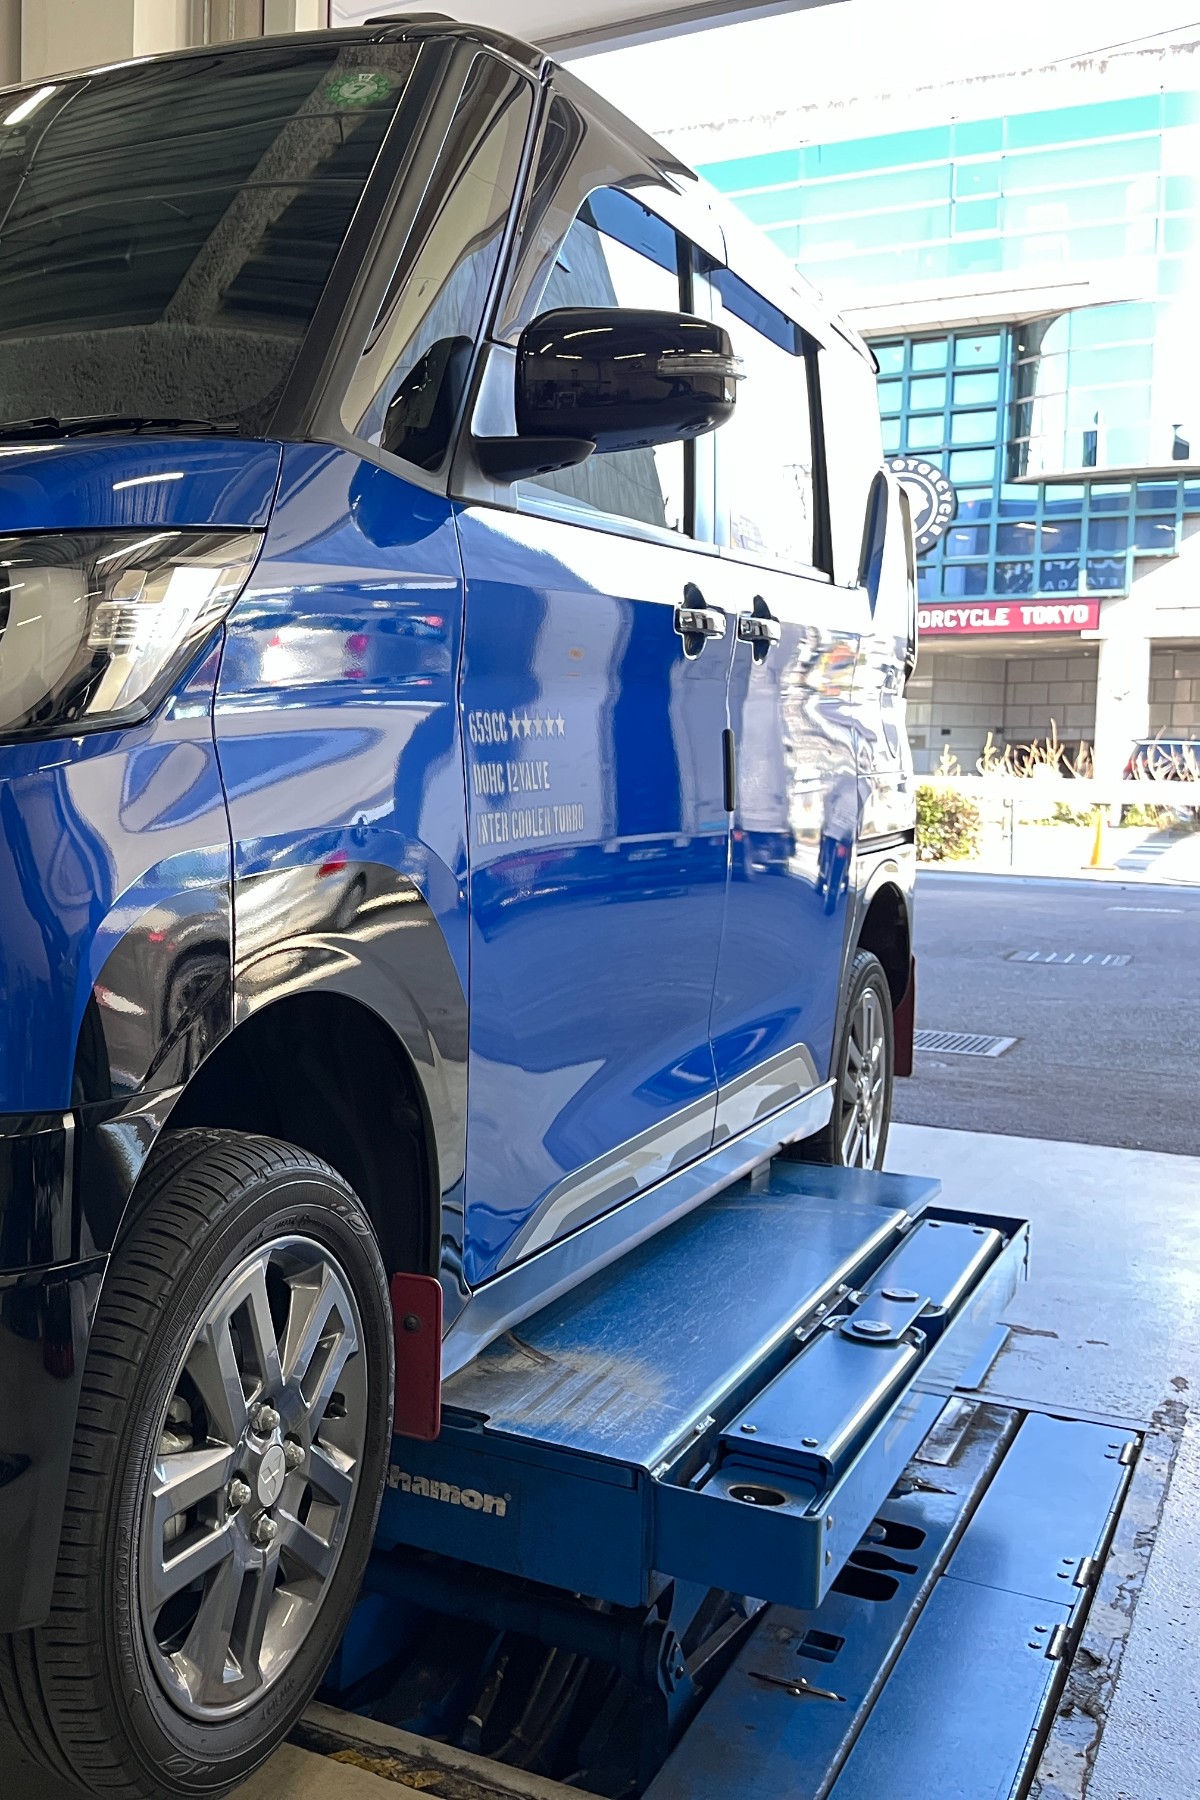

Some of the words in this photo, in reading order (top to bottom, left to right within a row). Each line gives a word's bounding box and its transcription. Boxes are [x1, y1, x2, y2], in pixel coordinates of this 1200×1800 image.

[917, 607, 1011, 629] ORCYCLE
[1020, 604, 1089, 625] TOKYO
[468, 711, 509, 744] 659CC
[473, 763, 505, 796] DOHC
[476, 812, 509, 846] INTER
[512, 807, 551, 841] COOLER
[553, 803, 585, 835] TURBO
[387, 1463, 507, 1518] hamon
